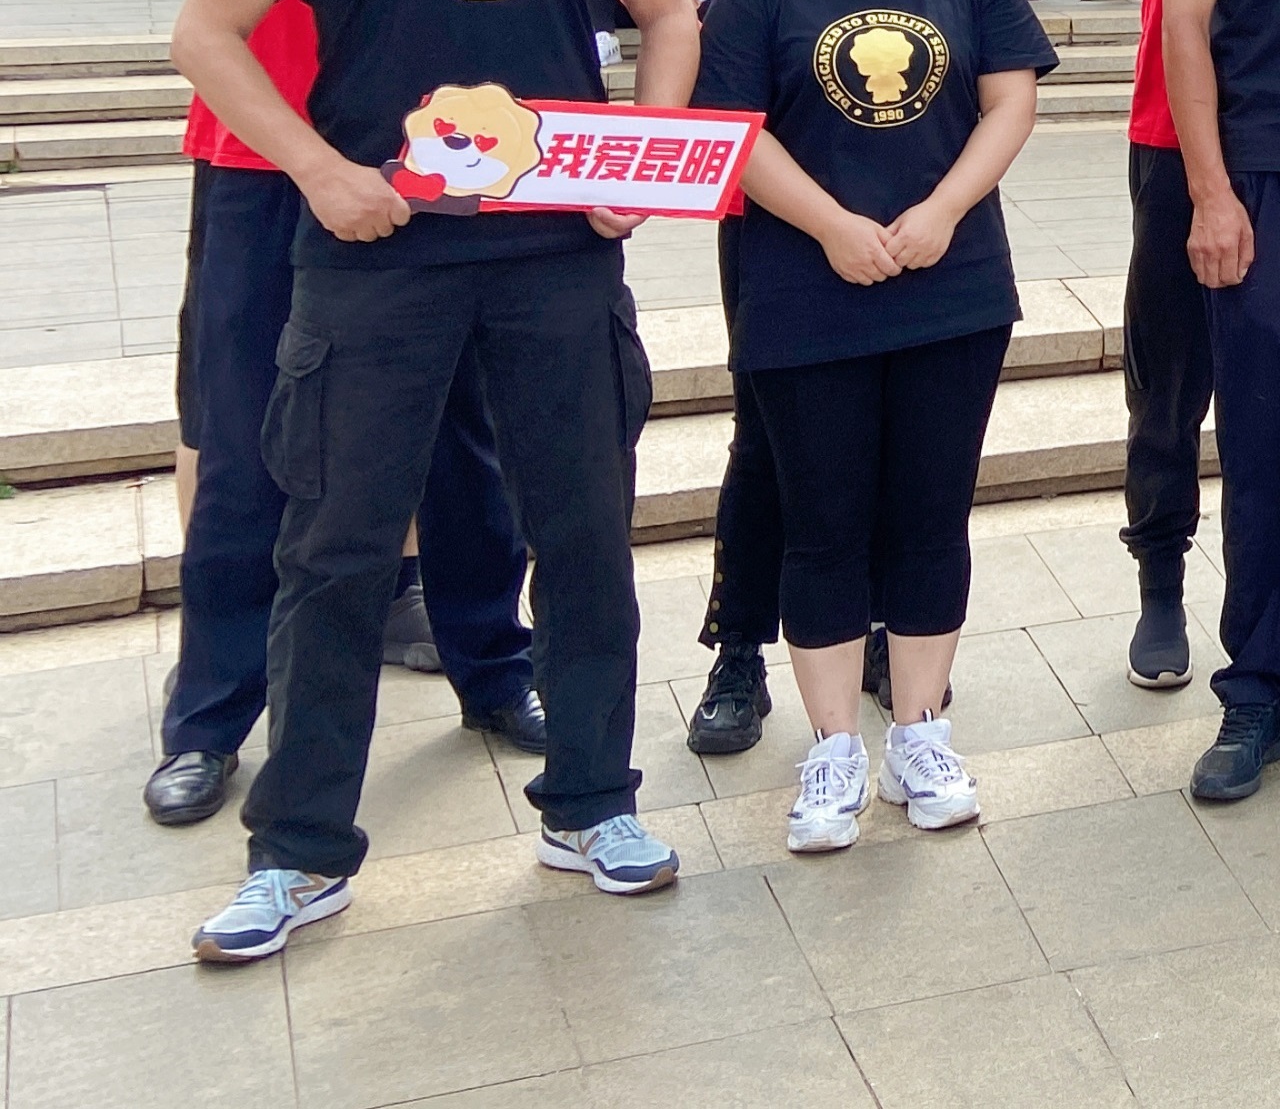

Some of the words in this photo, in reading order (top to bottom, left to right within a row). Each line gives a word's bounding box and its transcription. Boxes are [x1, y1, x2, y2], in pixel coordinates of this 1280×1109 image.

[818, 27, 851, 110] DEDICATED
[842, 17, 863, 31] TO
[865, 13, 934, 37] QUALITY
[922, 36, 947, 102] SERVICE
[872, 109, 905, 123] 1990
[537, 132, 736, 185] 我爱昆明
